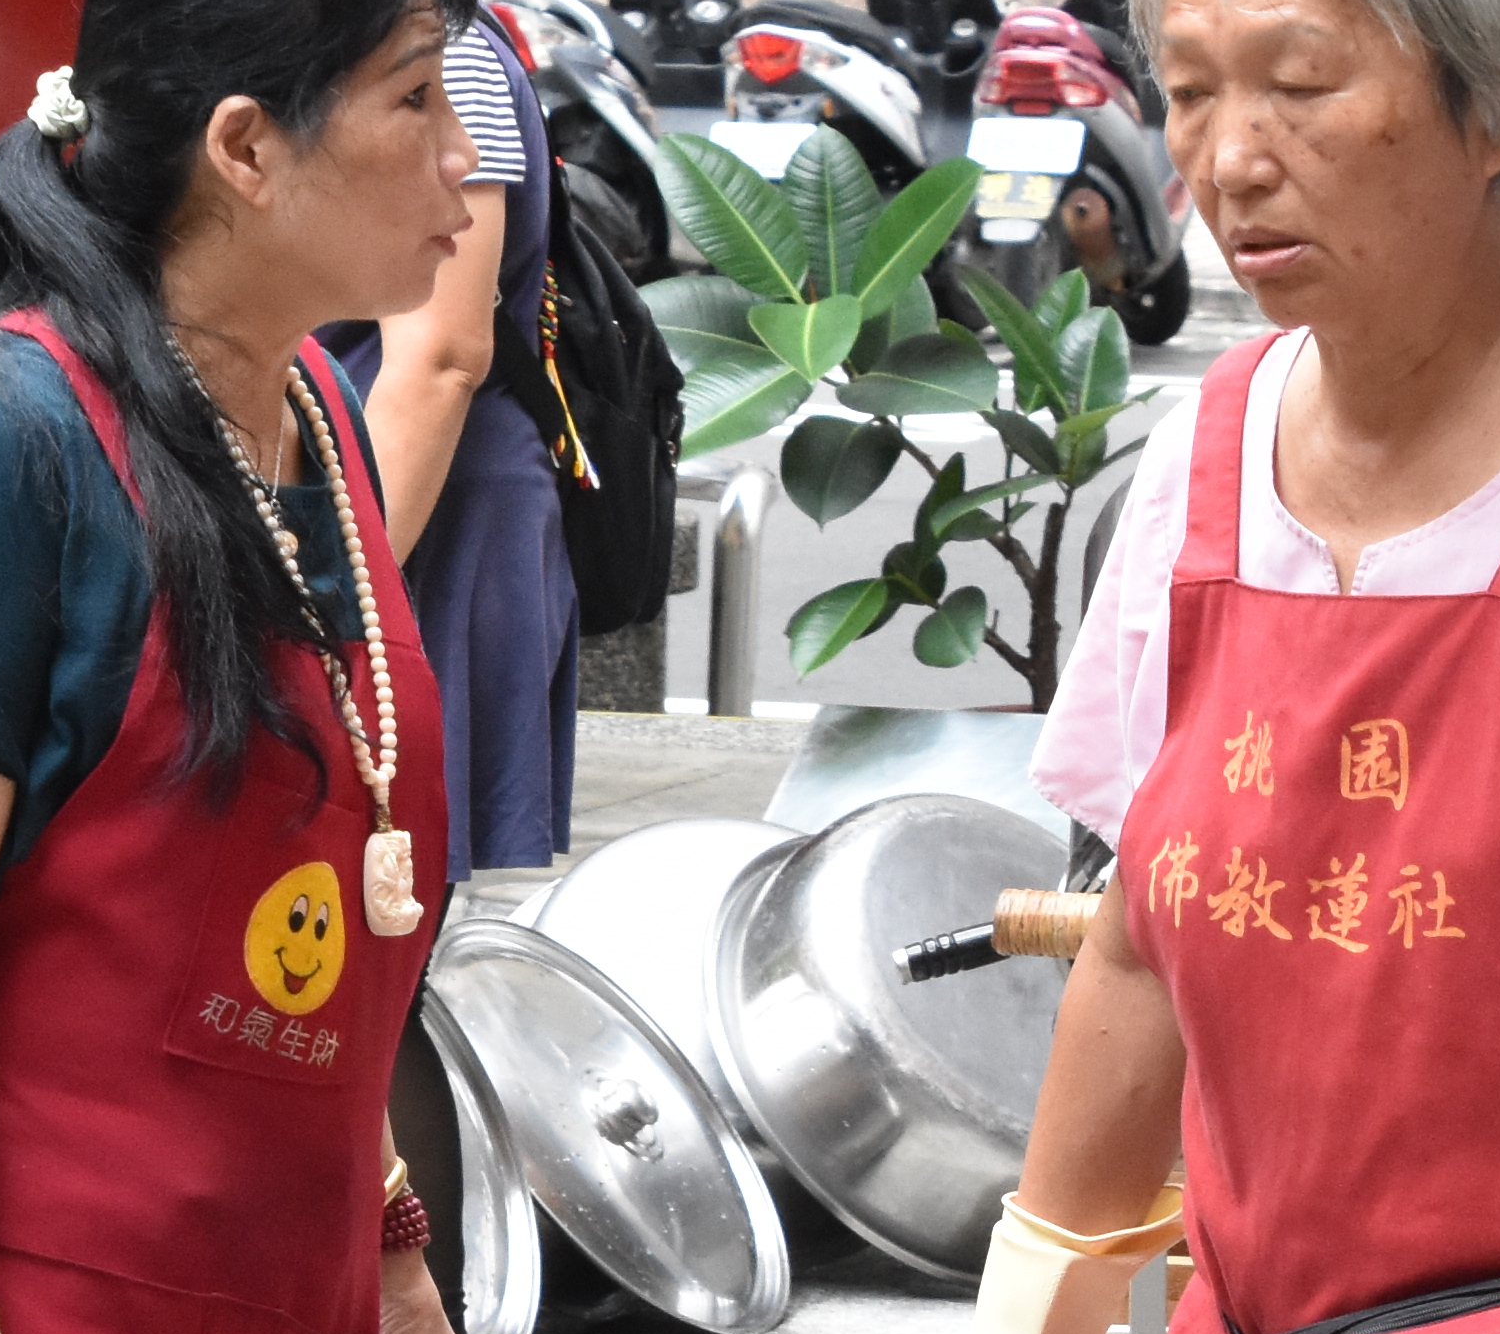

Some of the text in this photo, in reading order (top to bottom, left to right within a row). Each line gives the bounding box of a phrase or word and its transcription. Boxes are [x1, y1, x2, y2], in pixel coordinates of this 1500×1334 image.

[1223, 710, 1410, 811] 桃園
[1149, 831, 1466, 954] 佛教蓮社
[199, 992, 340, 1069] 和氣生財
